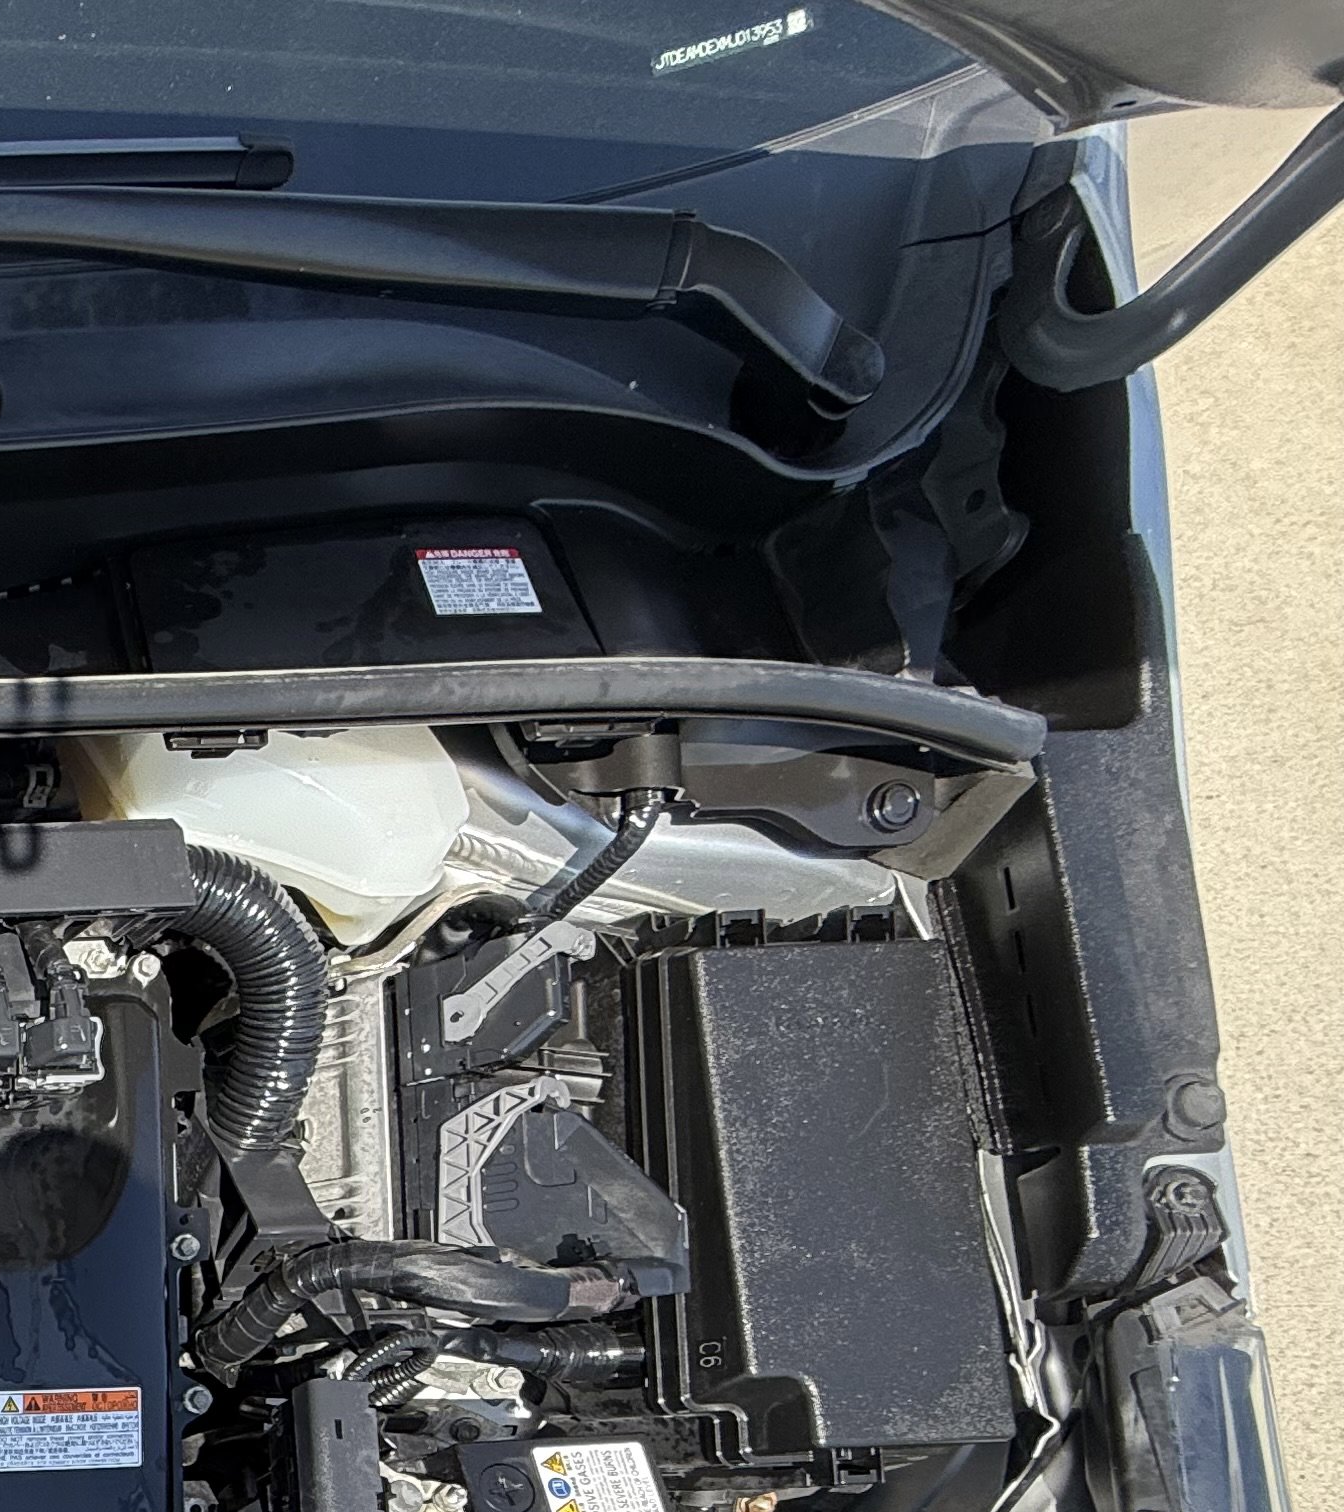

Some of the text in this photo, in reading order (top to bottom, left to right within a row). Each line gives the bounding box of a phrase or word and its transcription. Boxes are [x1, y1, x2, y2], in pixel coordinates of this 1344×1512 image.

[450, 549, 492, 558] DANGER
[570, 1450, 591, 1485] GASES
[601, 1449, 619, 1476] BURNS
[611, 1478, 630, 1508] SEVERE
